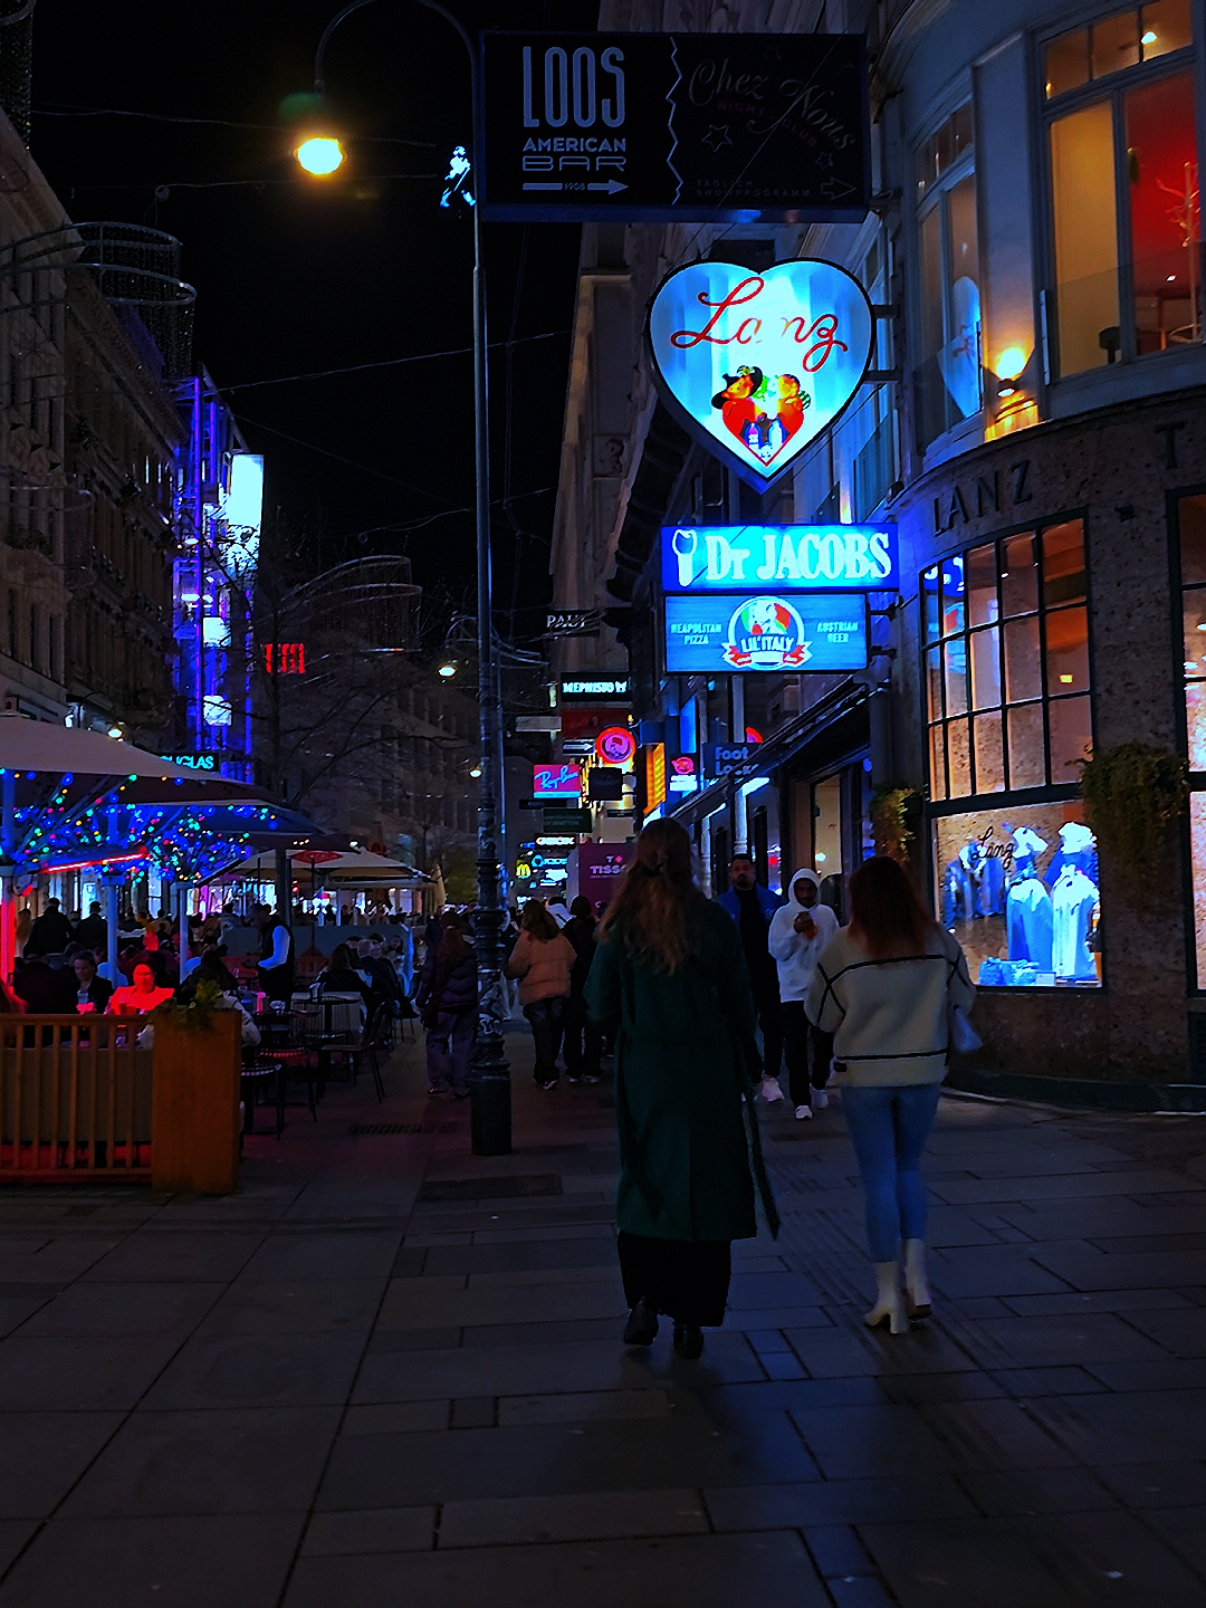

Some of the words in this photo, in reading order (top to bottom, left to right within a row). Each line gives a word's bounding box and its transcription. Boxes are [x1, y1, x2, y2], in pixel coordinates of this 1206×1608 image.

[522, 46, 627, 128] LOOS
[689, 56, 769, 107] Chez
[747, 79, 857, 150] Nous
[522, 137, 627, 152] AMERICAN
[522, 155, 627, 171] BAR
[670, 276, 849, 373] Lanz
[934, 459, 1033, 537] LANZ
[704, 535, 751, 580] Dr
[756, 532, 892, 580] JACOBS
[670, 623, 722, 634] NEAPOLITAN
[816, 621, 859, 632] AUSTRIAN
[684, 634, 709, 645] PIZZA
[715, 746, 749, 761] Foot
